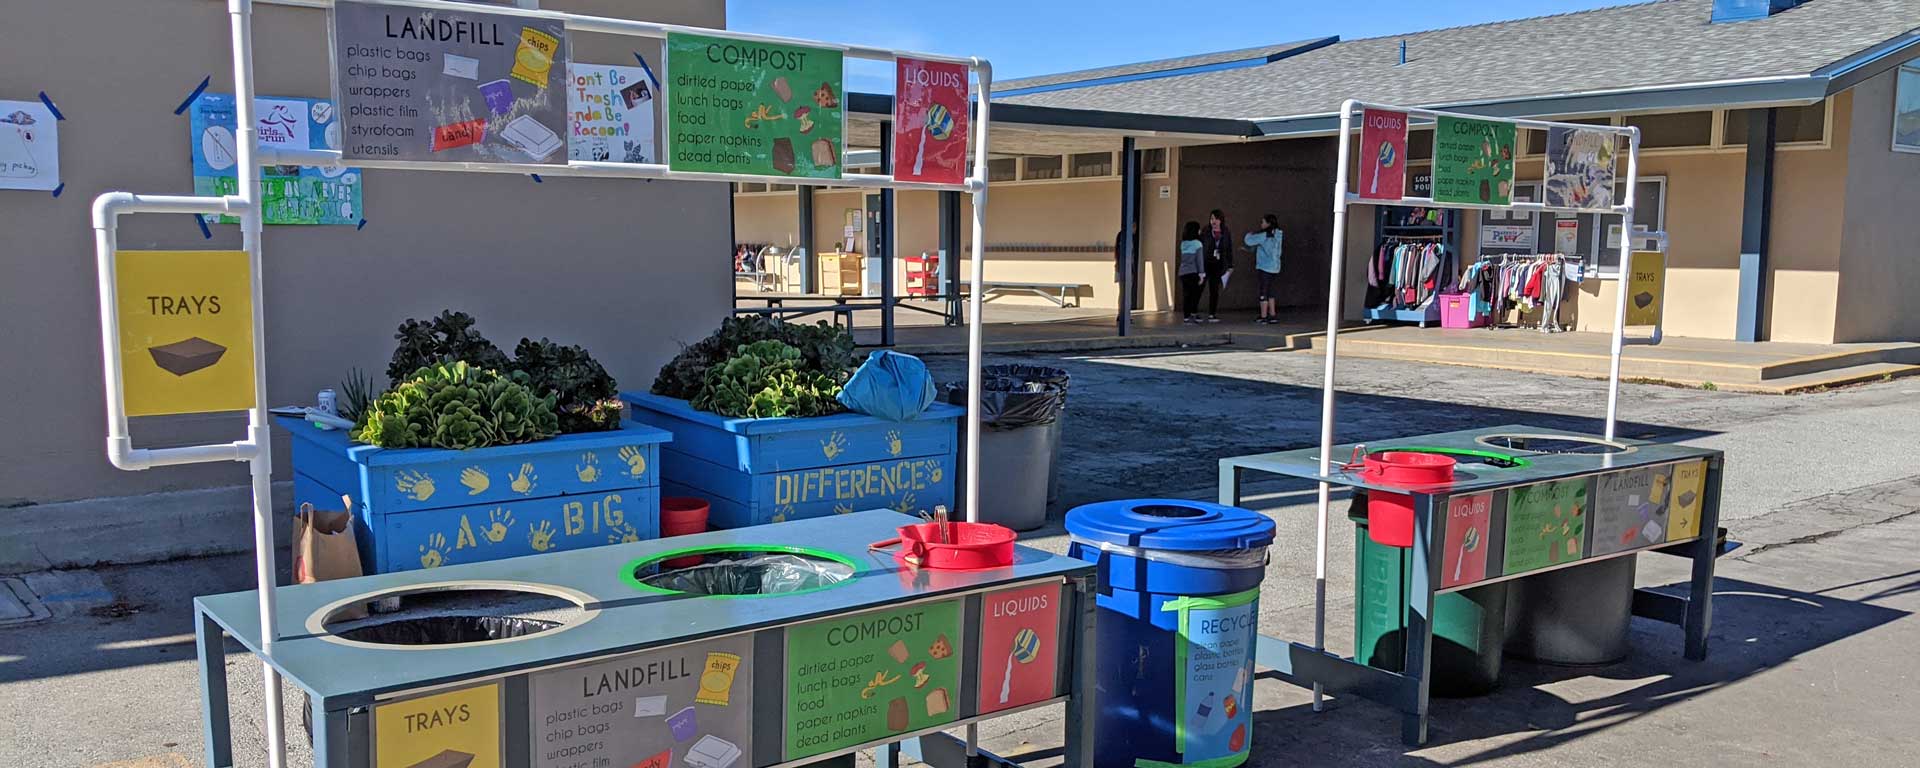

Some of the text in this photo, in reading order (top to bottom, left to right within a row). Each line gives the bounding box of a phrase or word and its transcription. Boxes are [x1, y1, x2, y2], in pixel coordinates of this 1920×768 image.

[386, 14, 505, 46] LANDFILL
[527, 36, 549, 52] chips
[347, 44, 431, 63] plastic bags
[706, 43, 807, 72] COMPOST
[347, 63, 417, 81] chip bags
[609, 69, 626, 86] Be
[905, 67, 961, 89] LIQUIDS
[677, 73, 756, 92] dirtied paper
[349, 86, 411, 99] wrappers
[576, 87, 623, 106] Trash
[677, 92, 743, 110] lunch bags
[350, 103, 418, 118] plastic film
[605, 106, 622, 121] Be
[677, 111, 706, 125] food
[351, 123, 415, 138] styrofoam
[574, 121, 629, 137] Racoon!
[1368, 115, 1402, 130] LIQUIDS
[441, 123, 474, 141] candy
[678, 132, 762, 148] paper napkins
[352, 143, 400, 156] utensils
[678, 148, 752, 165] dead plants
[1636, 272, 1656, 282] TRAYS
[147, 296, 222, 316] TRAYS
[775, 461, 926, 505] DIFFERENCE
[1612, 474, 1649, 492] LANDFILL
[1453, 502, 1486, 518] LIQUIDS
[456, 494, 625, 550] A BIG
[993, 594, 1048, 618] LIQUIDS
[827, 612, 924, 647] COMPOST
[711, 660, 731, 673] chips
[797, 653, 875, 677] dirtied paper
[583, 657, 691, 698] LANDFILL
[797, 674, 861, 695] lunch bags
[797, 696, 825, 712] food
[403, 703, 471, 734] TRAYS
[546, 700, 624, 727] plastic bags
[796, 704, 878, 734] paper napkins
[546, 722, 611, 743] chip bags
[796, 724, 866, 749] dead plants
[547, 741, 604, 760] wrappers
[593, 756, 610, 768] film
